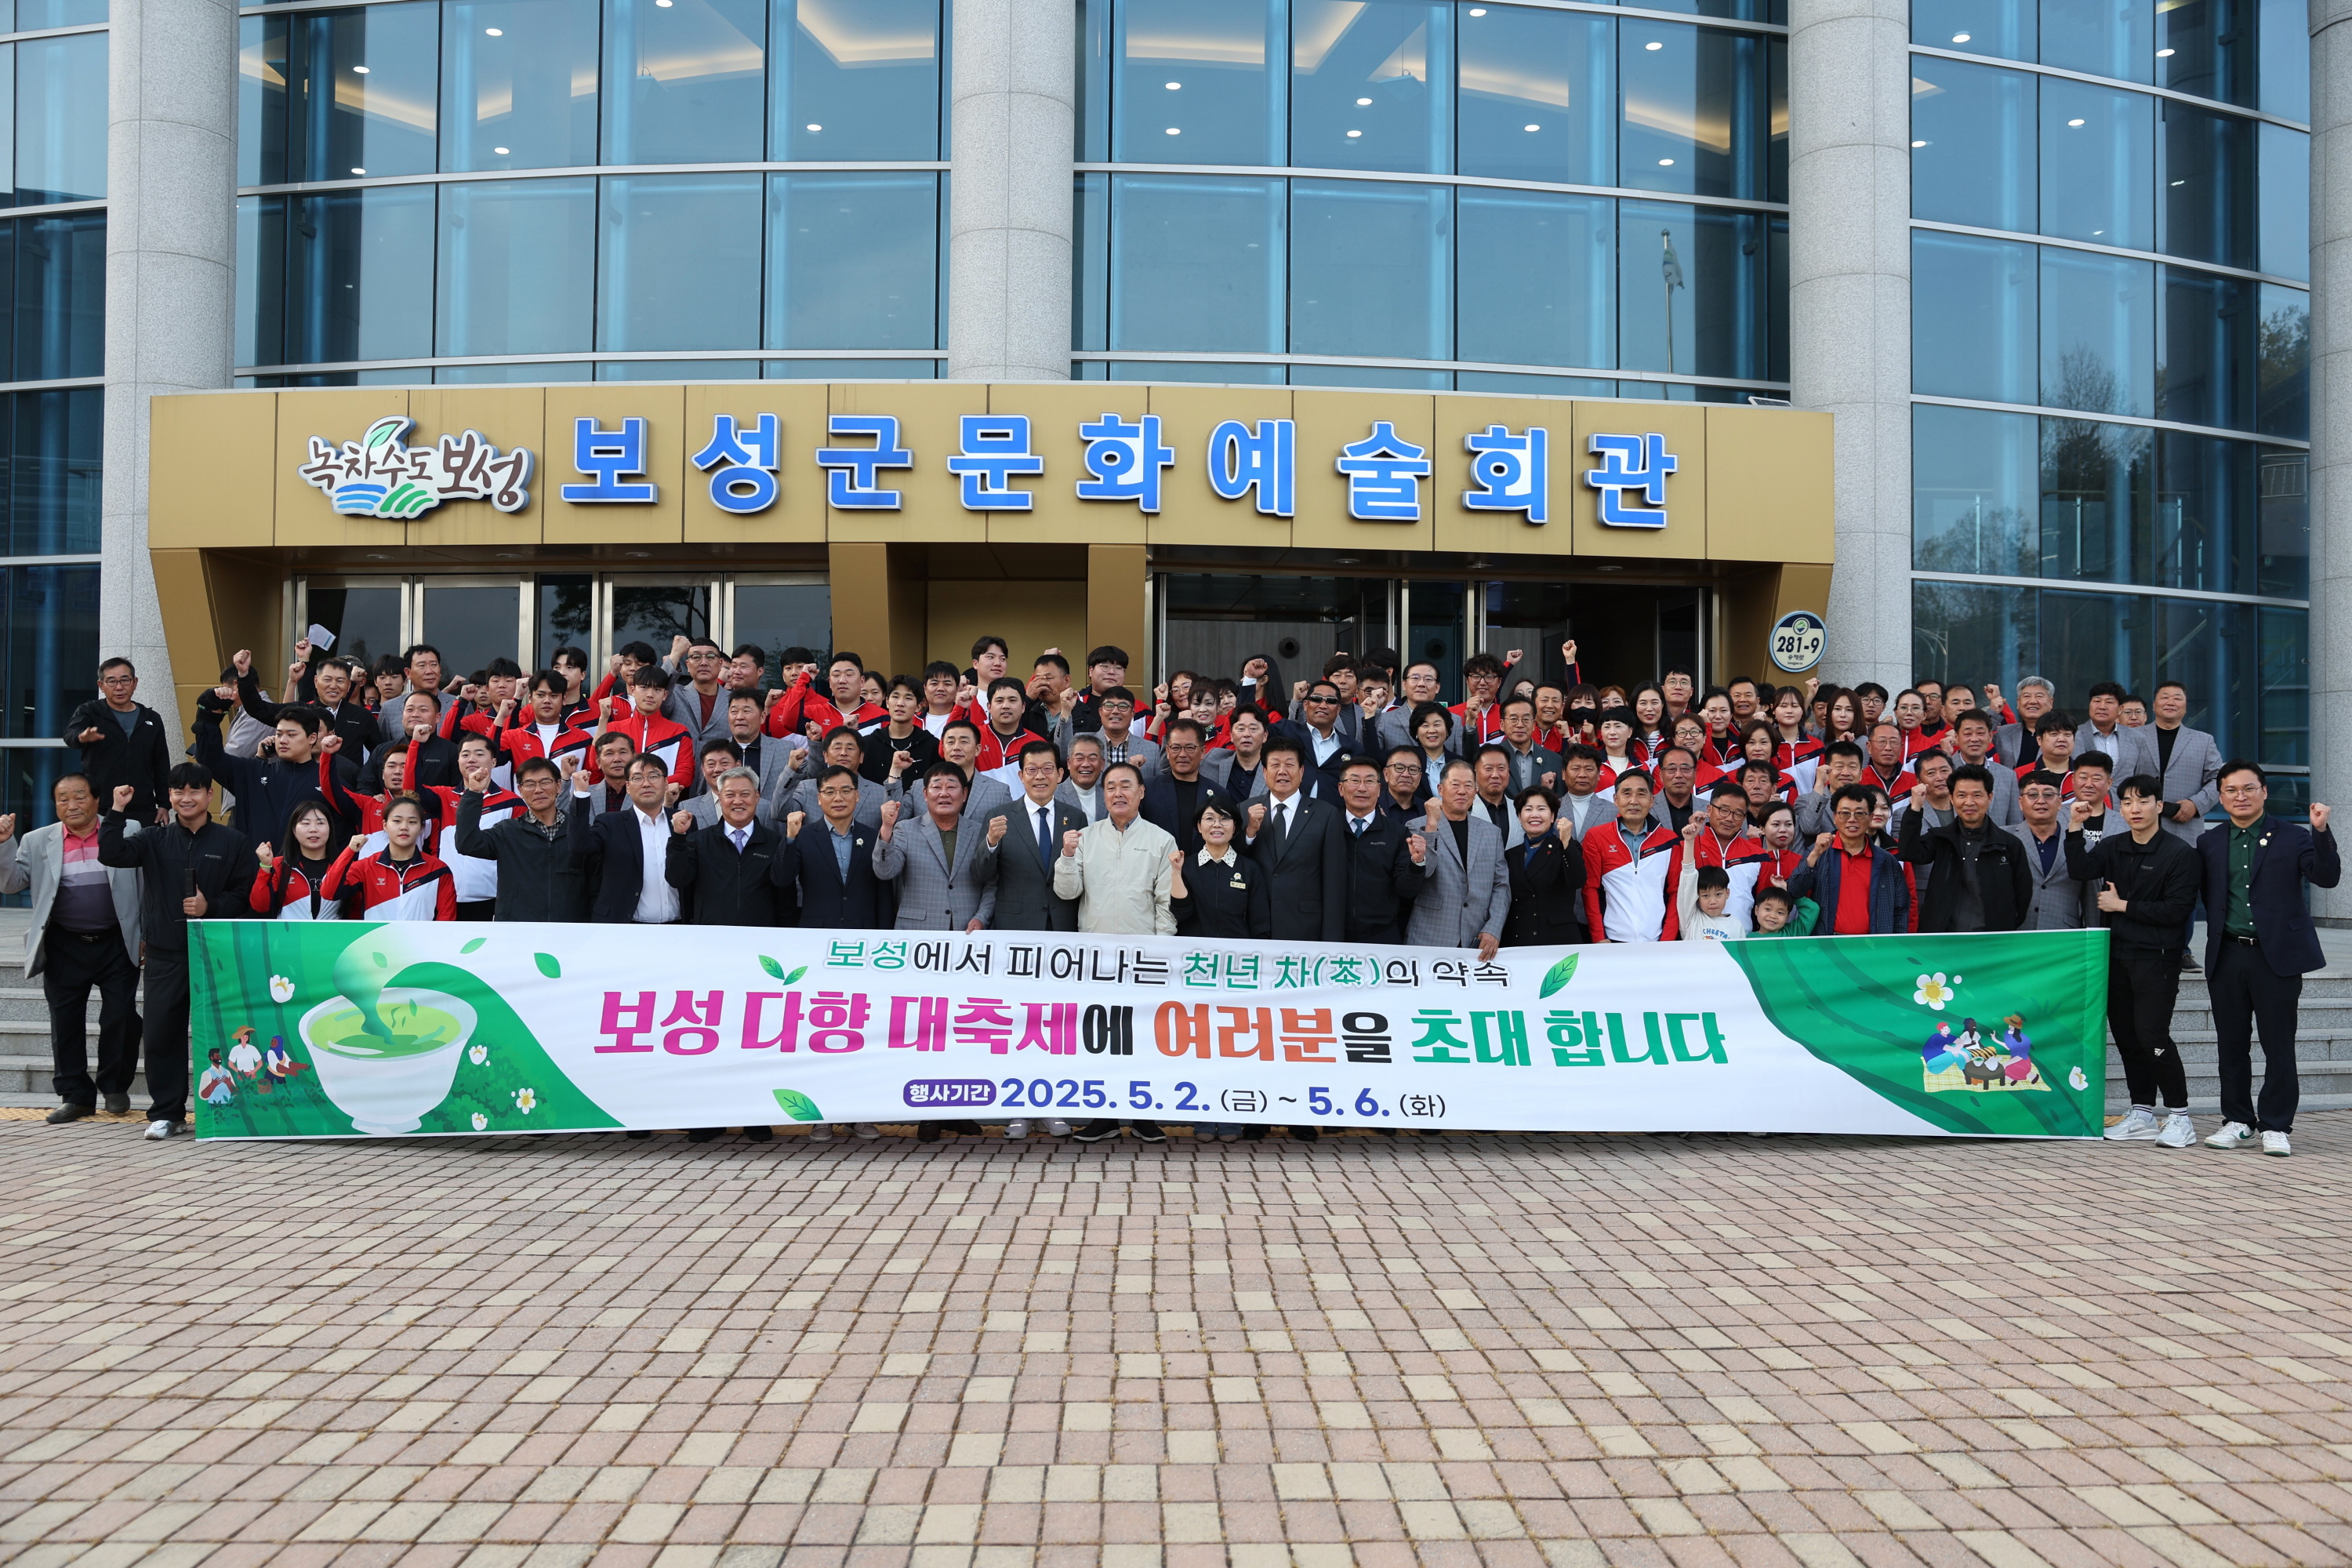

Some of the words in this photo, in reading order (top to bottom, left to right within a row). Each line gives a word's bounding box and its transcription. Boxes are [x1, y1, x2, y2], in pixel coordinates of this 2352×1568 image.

[303, 441, 433, 490] 녹차수도
[437, 434, 524, 506] 보성
[561, 413, 1677, 528] 보성군문화예술회관
[1776, 636, 1820, 653] 281-9
[827, 941, 992, 975] 보성에서
[1007, 946, 1169, 985] 피어나는
[1184, 953, 1259, 989] 천년
[1274, 956, 1420, 988] 차(茶)의
[1432, 956, 1509, 987] 약속
[594, 990, 724, 1055] 보성
[741, 991, 871, 1054] 다향
[887, 996, 1133, 1056] 대축제에
[1154, 1000, 1392, 1064] 여러분을
[909, 1083, 991, 1102] 행사기간
